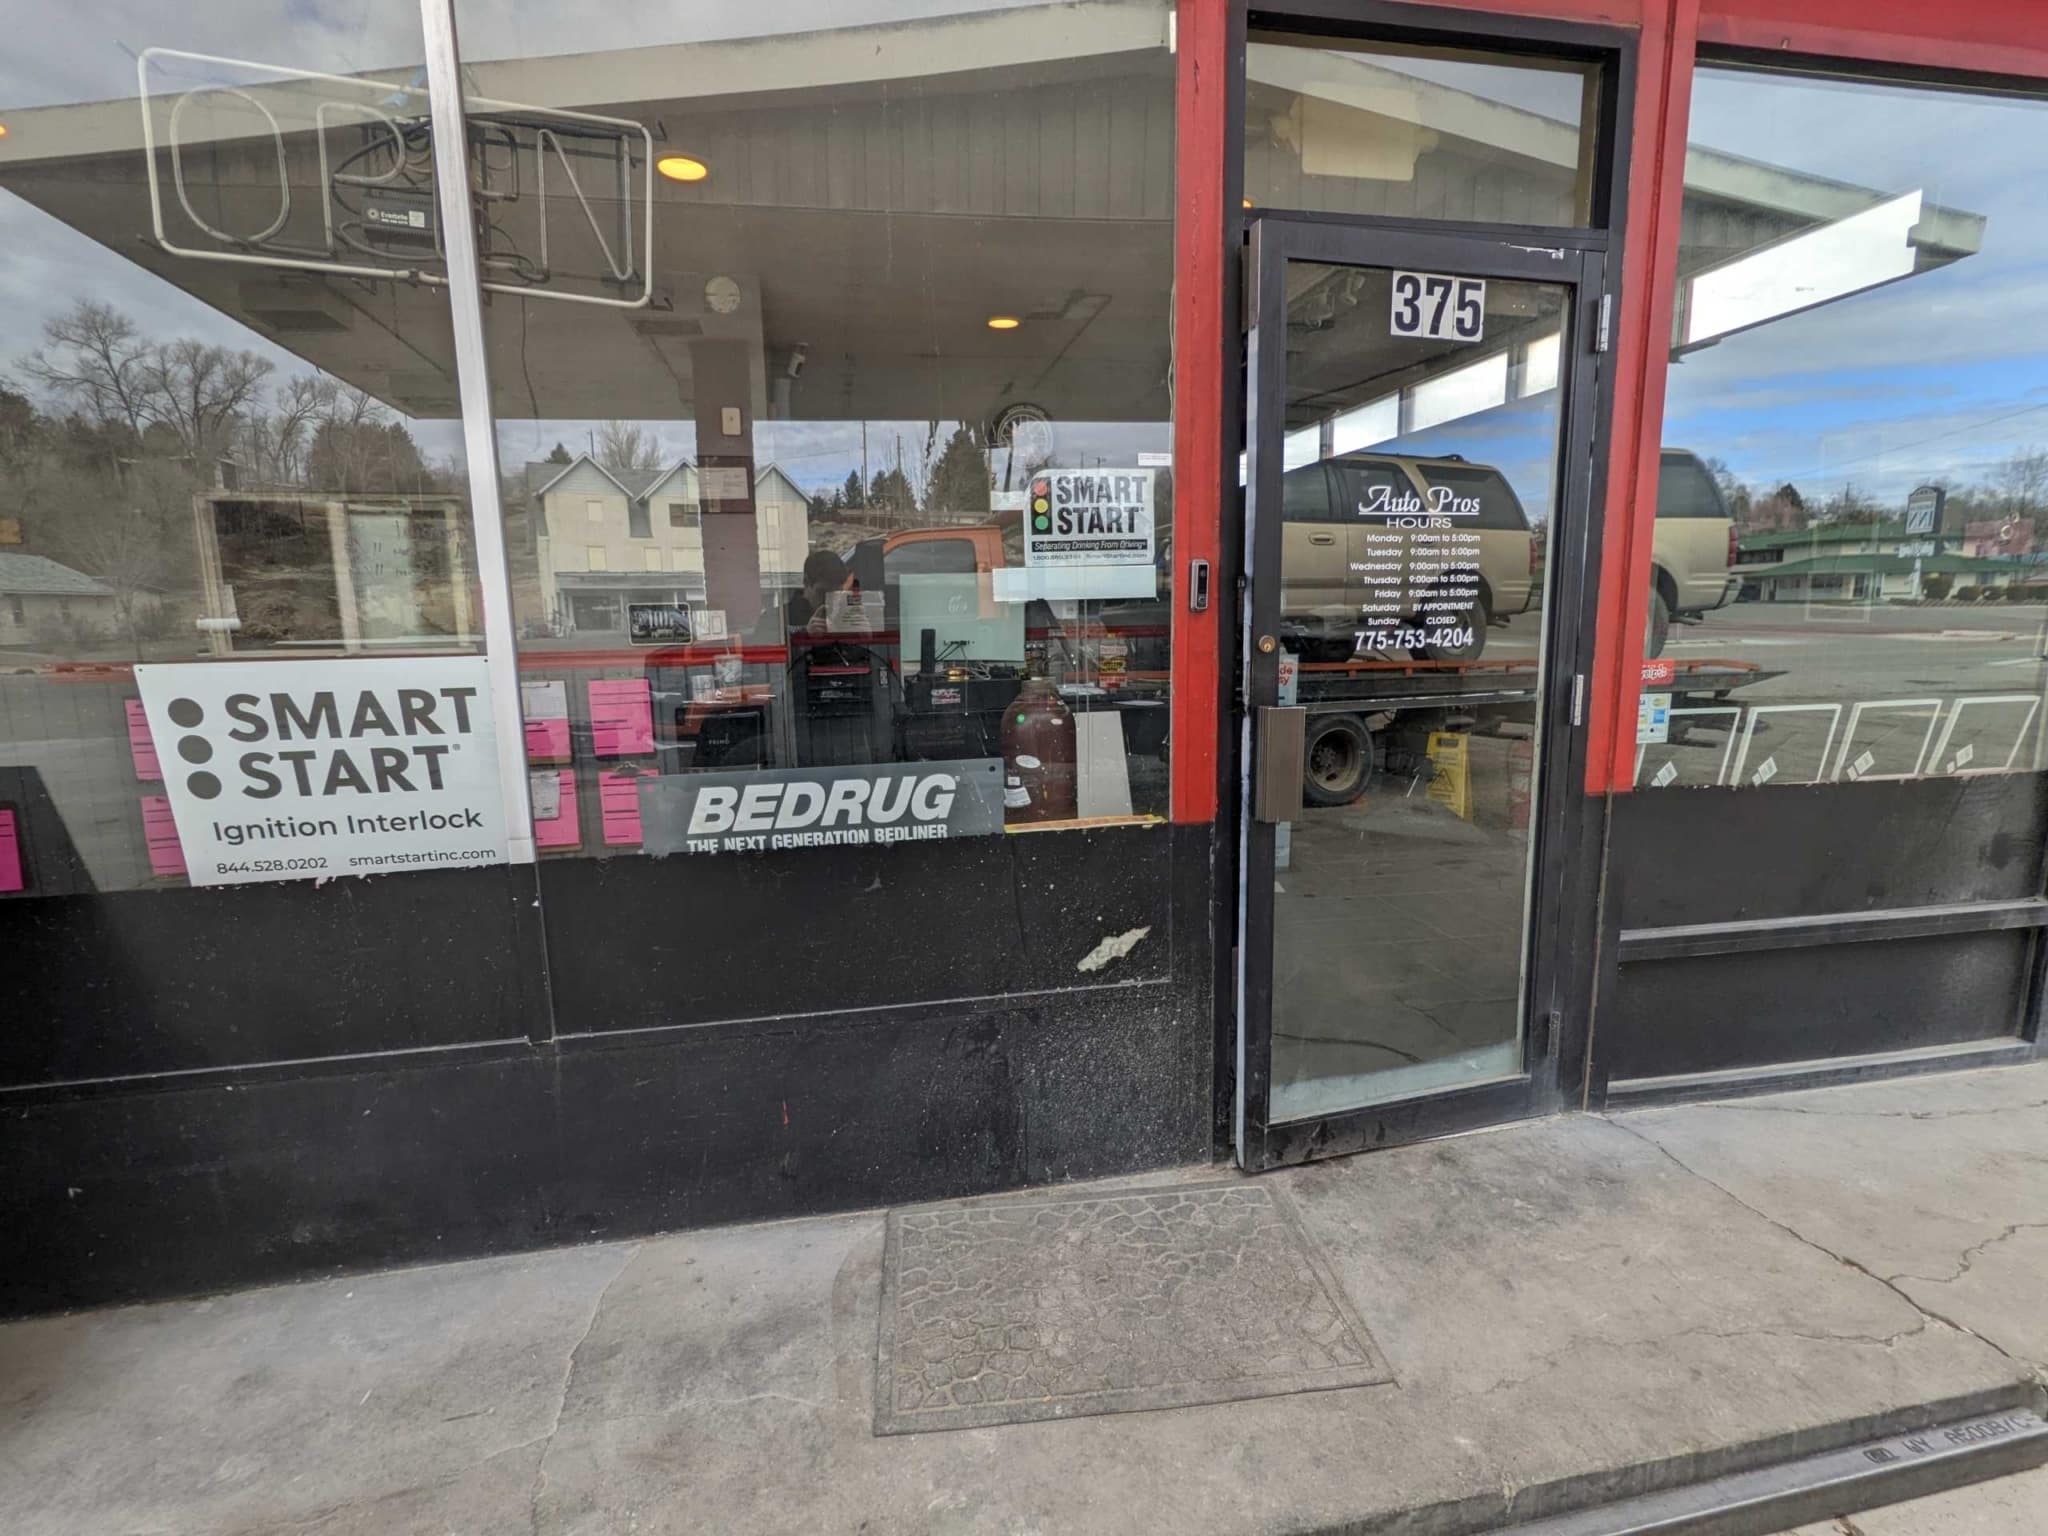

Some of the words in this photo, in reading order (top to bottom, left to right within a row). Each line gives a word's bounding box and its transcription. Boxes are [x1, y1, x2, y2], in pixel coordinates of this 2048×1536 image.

[1395, 275, 1482, 337] 375
[1056, 476, 1148, 505] SMART
[1358, 485, 1421, 513] Auto
[1427, 486, 1481, 513] Pros
[1056, 506, 1140, 535] START
[1386, 517, 1453, 529] HOURS
[1034, 541, 1071, 551] Separating
[1072, 541, 1099, 550] Drinking
[1100, 540, 1119, 549] From
[1366, 534, 1403, 544] Monday
[1410, 534, 1441, 543] 9:00am
[1442, 534, 1450, 543] to
[1451, 534, 1481, 544] 5:00pm
[1366, 548, 1403, 558] Tuesday
[1409, 548, 1440, 557] 9:00am
[1441, 548, 1449, 556] to
[1350, 562, 1402, 572] Wednesday
[1409, 561, 1440, 571] 9:00am
[1441, 561, 1449, 570] to
[1364, 575, 1402, 585] Thursday
[1408, 575, 1439, 584] 9:00am
[1440, 574, 1448, 583] to
[1374, 589, 1401, 599] Friday
[1408, 589, 1438, 598] 9:00am
[1439, 589, 1447, 597] to
[1362, 603, 1401, 613] Saturday
[1412, 603, 1422, 611] BY
[1422, 602, 1474, 611] APPOINTMENT
[1367, 616, 1401, 626] Sunday
[1425, 616, 1457, 625] CLOSED
[1354, 627, 1475, 651] 775-753-4204
[224, 686, 477, 742] SMART
[238, 743, 450, 799] START
[687, 773, 957, 835] BEDRUG
[213, 813, 338, 846] Ignition
[346, 807, 484, 836] Interlock
[687, 838, 718, 855] THE
[724, 835, 767, 852] NEXT
[772, 829, 870, 851] GENERATION
[875, 824, 948, 844] BEDLINER
[216, 856, 329, 875] 844.528.0202
[348, 846, 497, 868] smartstartinc.com
